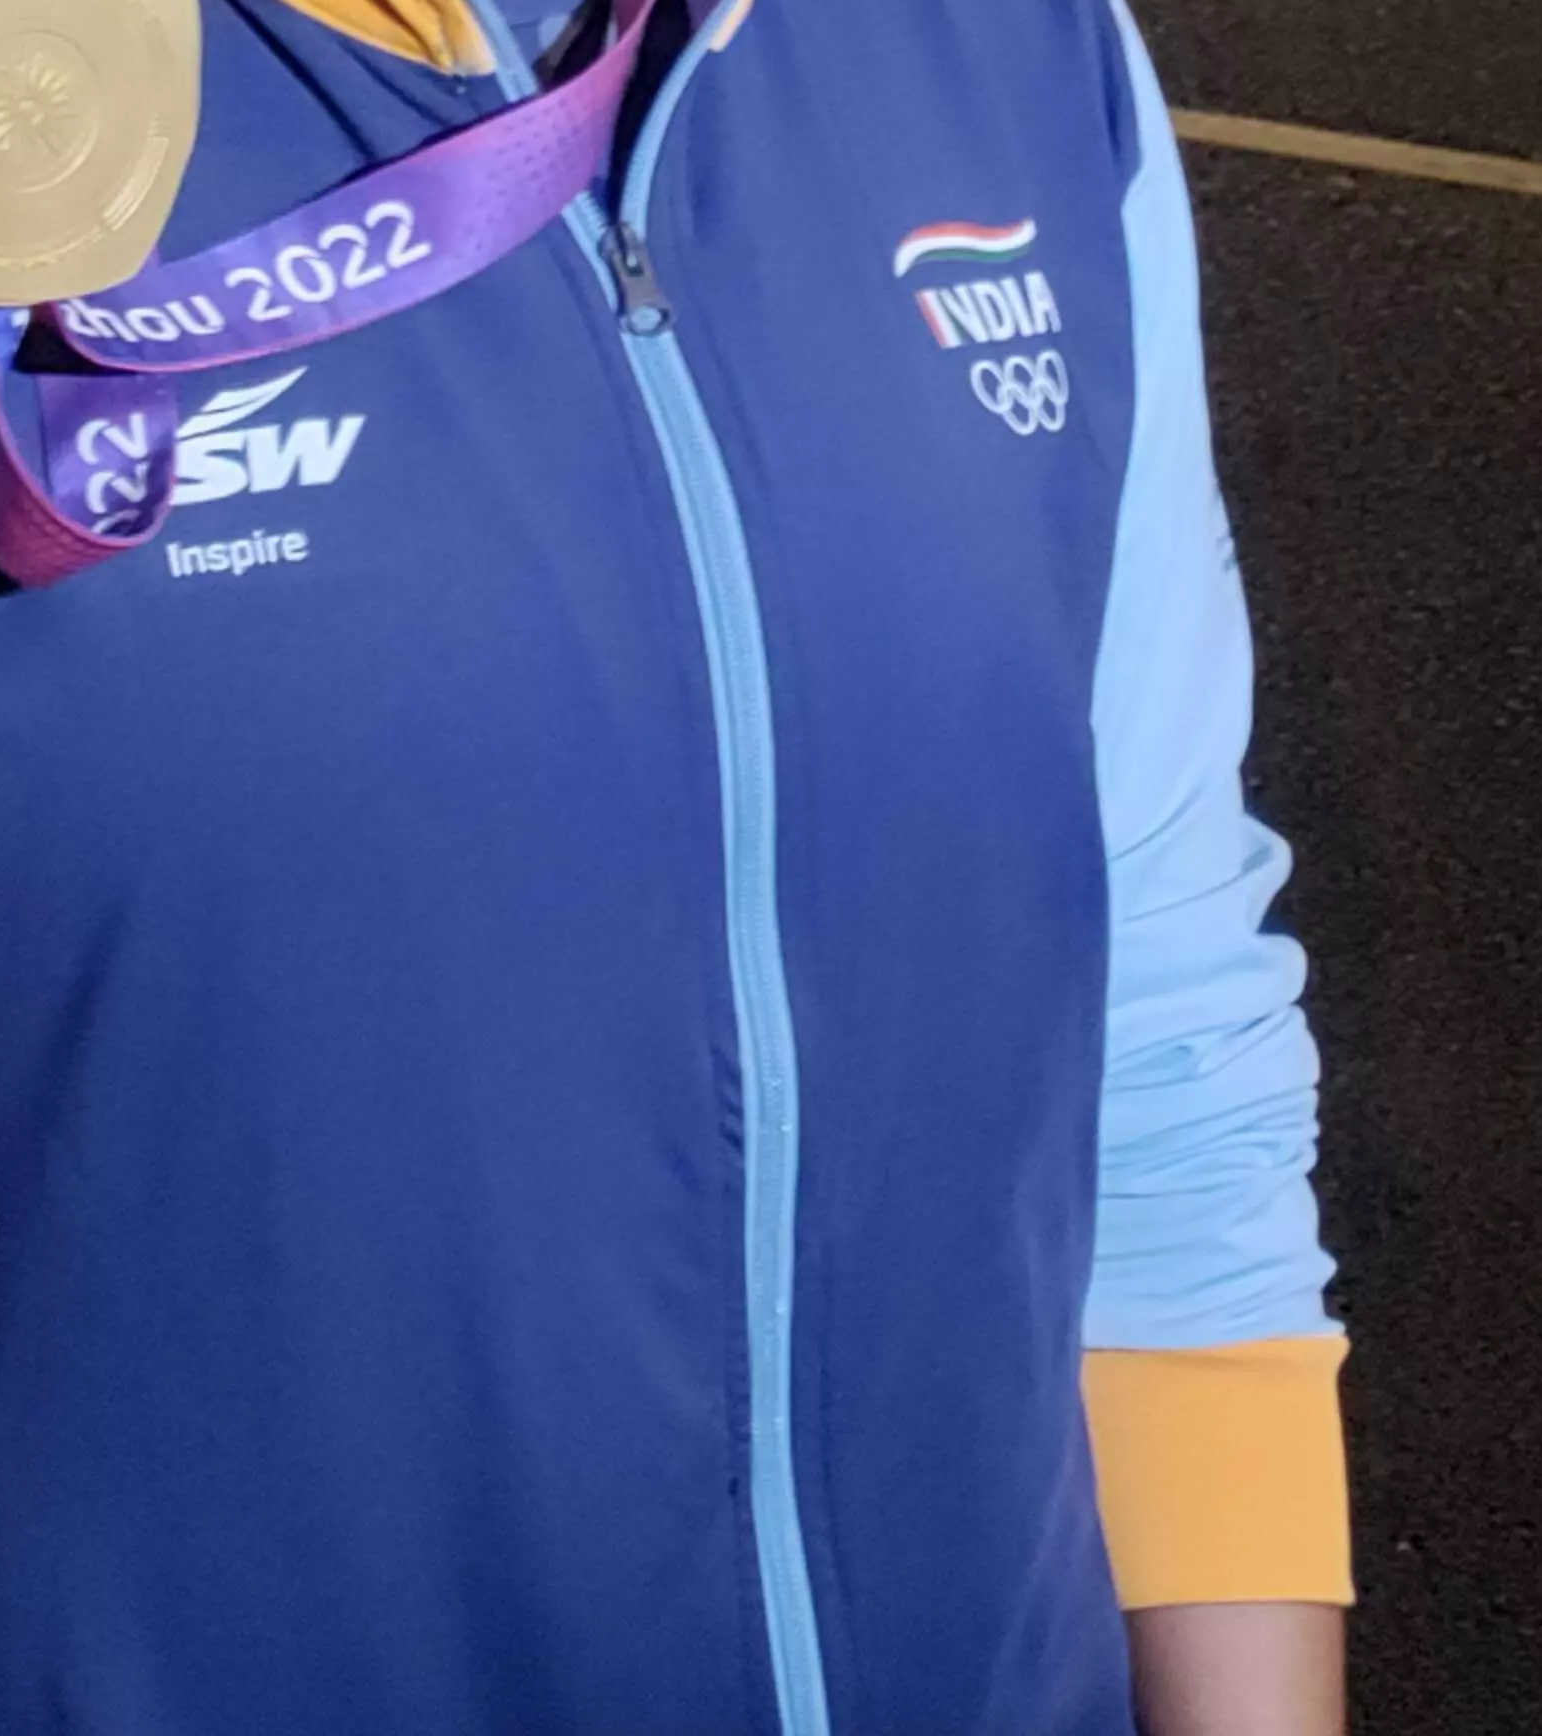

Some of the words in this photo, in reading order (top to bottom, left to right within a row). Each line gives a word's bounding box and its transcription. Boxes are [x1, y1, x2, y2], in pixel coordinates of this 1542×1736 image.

[224, 199, 433, 323] 2022
[915, 270, 1062, 349] INDIA
[165, 528, 309, 579] Inspire
